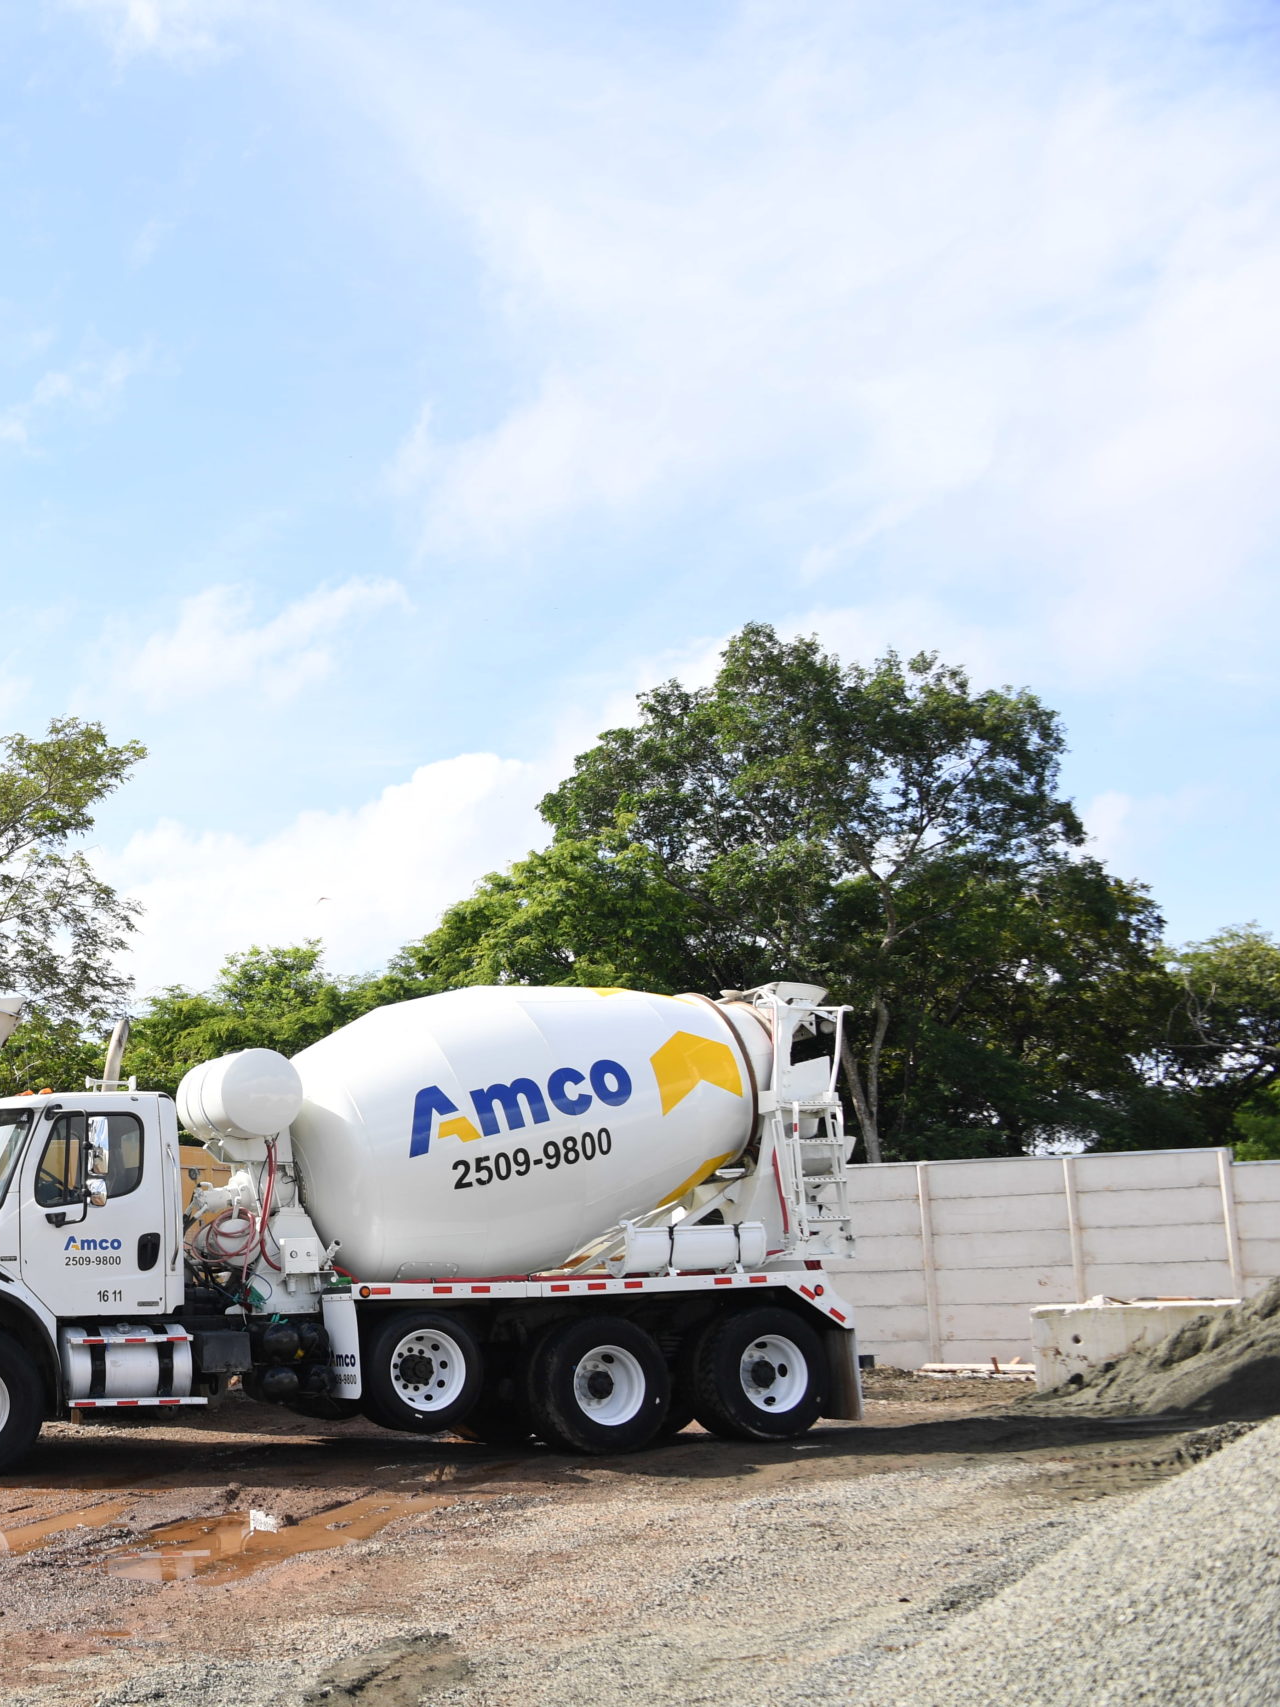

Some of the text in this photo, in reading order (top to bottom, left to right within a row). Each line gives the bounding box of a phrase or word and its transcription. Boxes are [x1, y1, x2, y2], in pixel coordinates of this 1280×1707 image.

[409, 1059, 632, 1158] Amco
[451, 1127, 612, 1190] 2509-9800
[64, 1235, 122, 1251] Amco
[65, 1255, 122, 1266] 2509-9800
